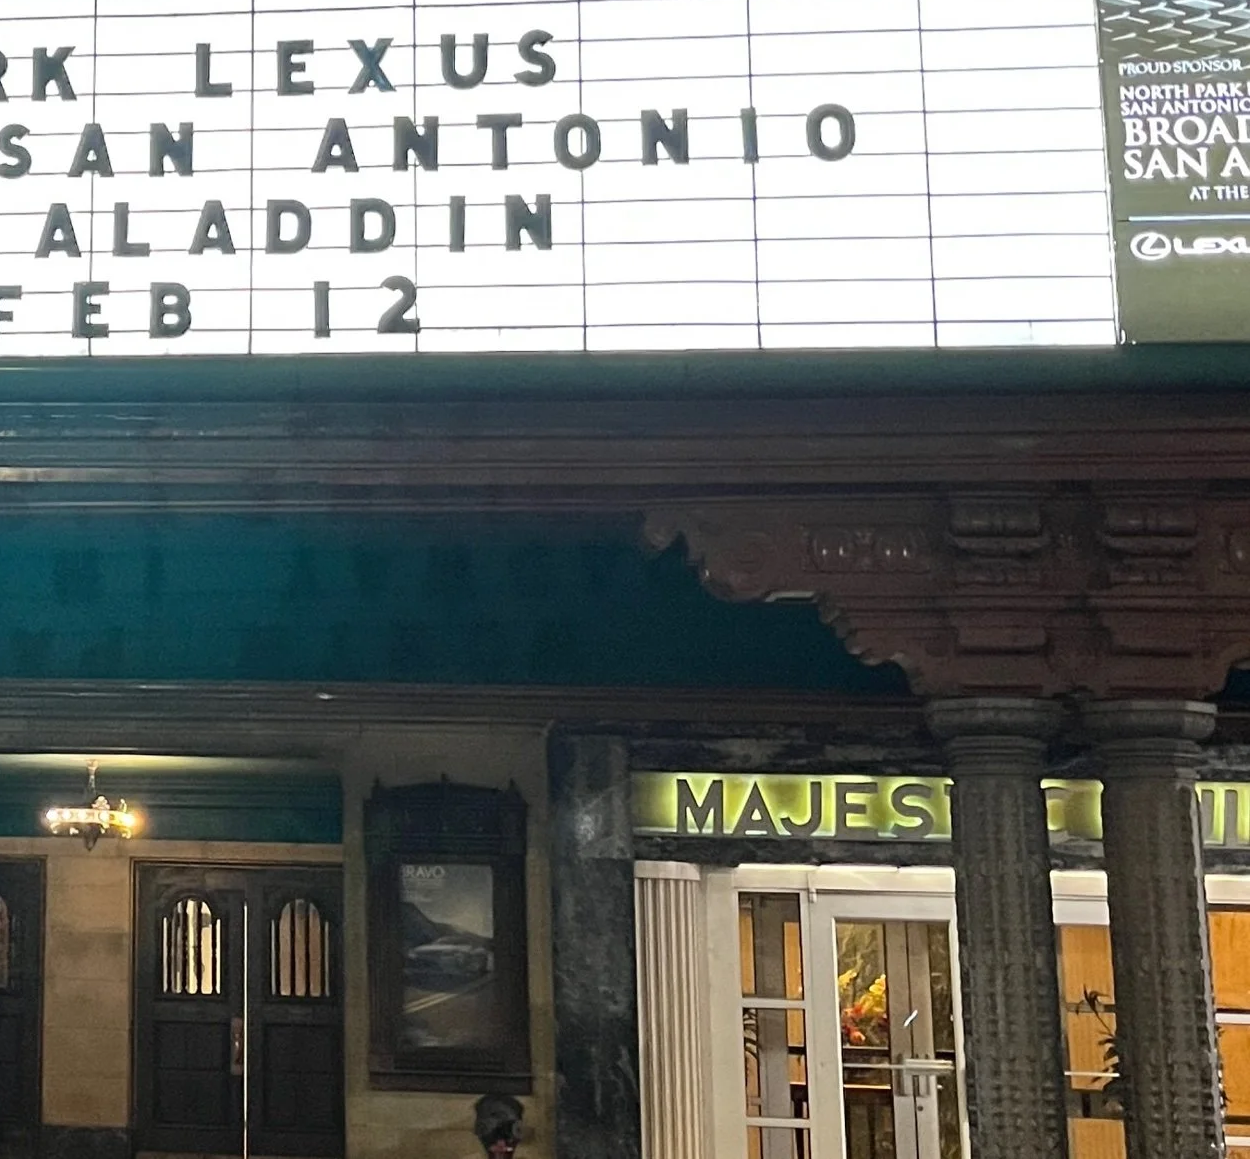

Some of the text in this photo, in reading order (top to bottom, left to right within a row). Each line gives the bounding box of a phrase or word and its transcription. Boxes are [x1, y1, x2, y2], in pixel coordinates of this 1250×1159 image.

[195, 30, 555, 97] LEXUS
[1118, 59, 1243, 76] PROUD SPONSOR
[1120, 83, 1189, 100] NORTH
[1195, 82, 1244, 98] PARK
[1120, 101, 1157, 116] SAN
[311, 103, 855, 173] ANTONIO
[1123, 147, 1208, 179] SAN
[1190, 185, 1249, 200] AT THE
[35, 194, 552, 258] ALADDIN
[314, 275, 421, 337] 12
